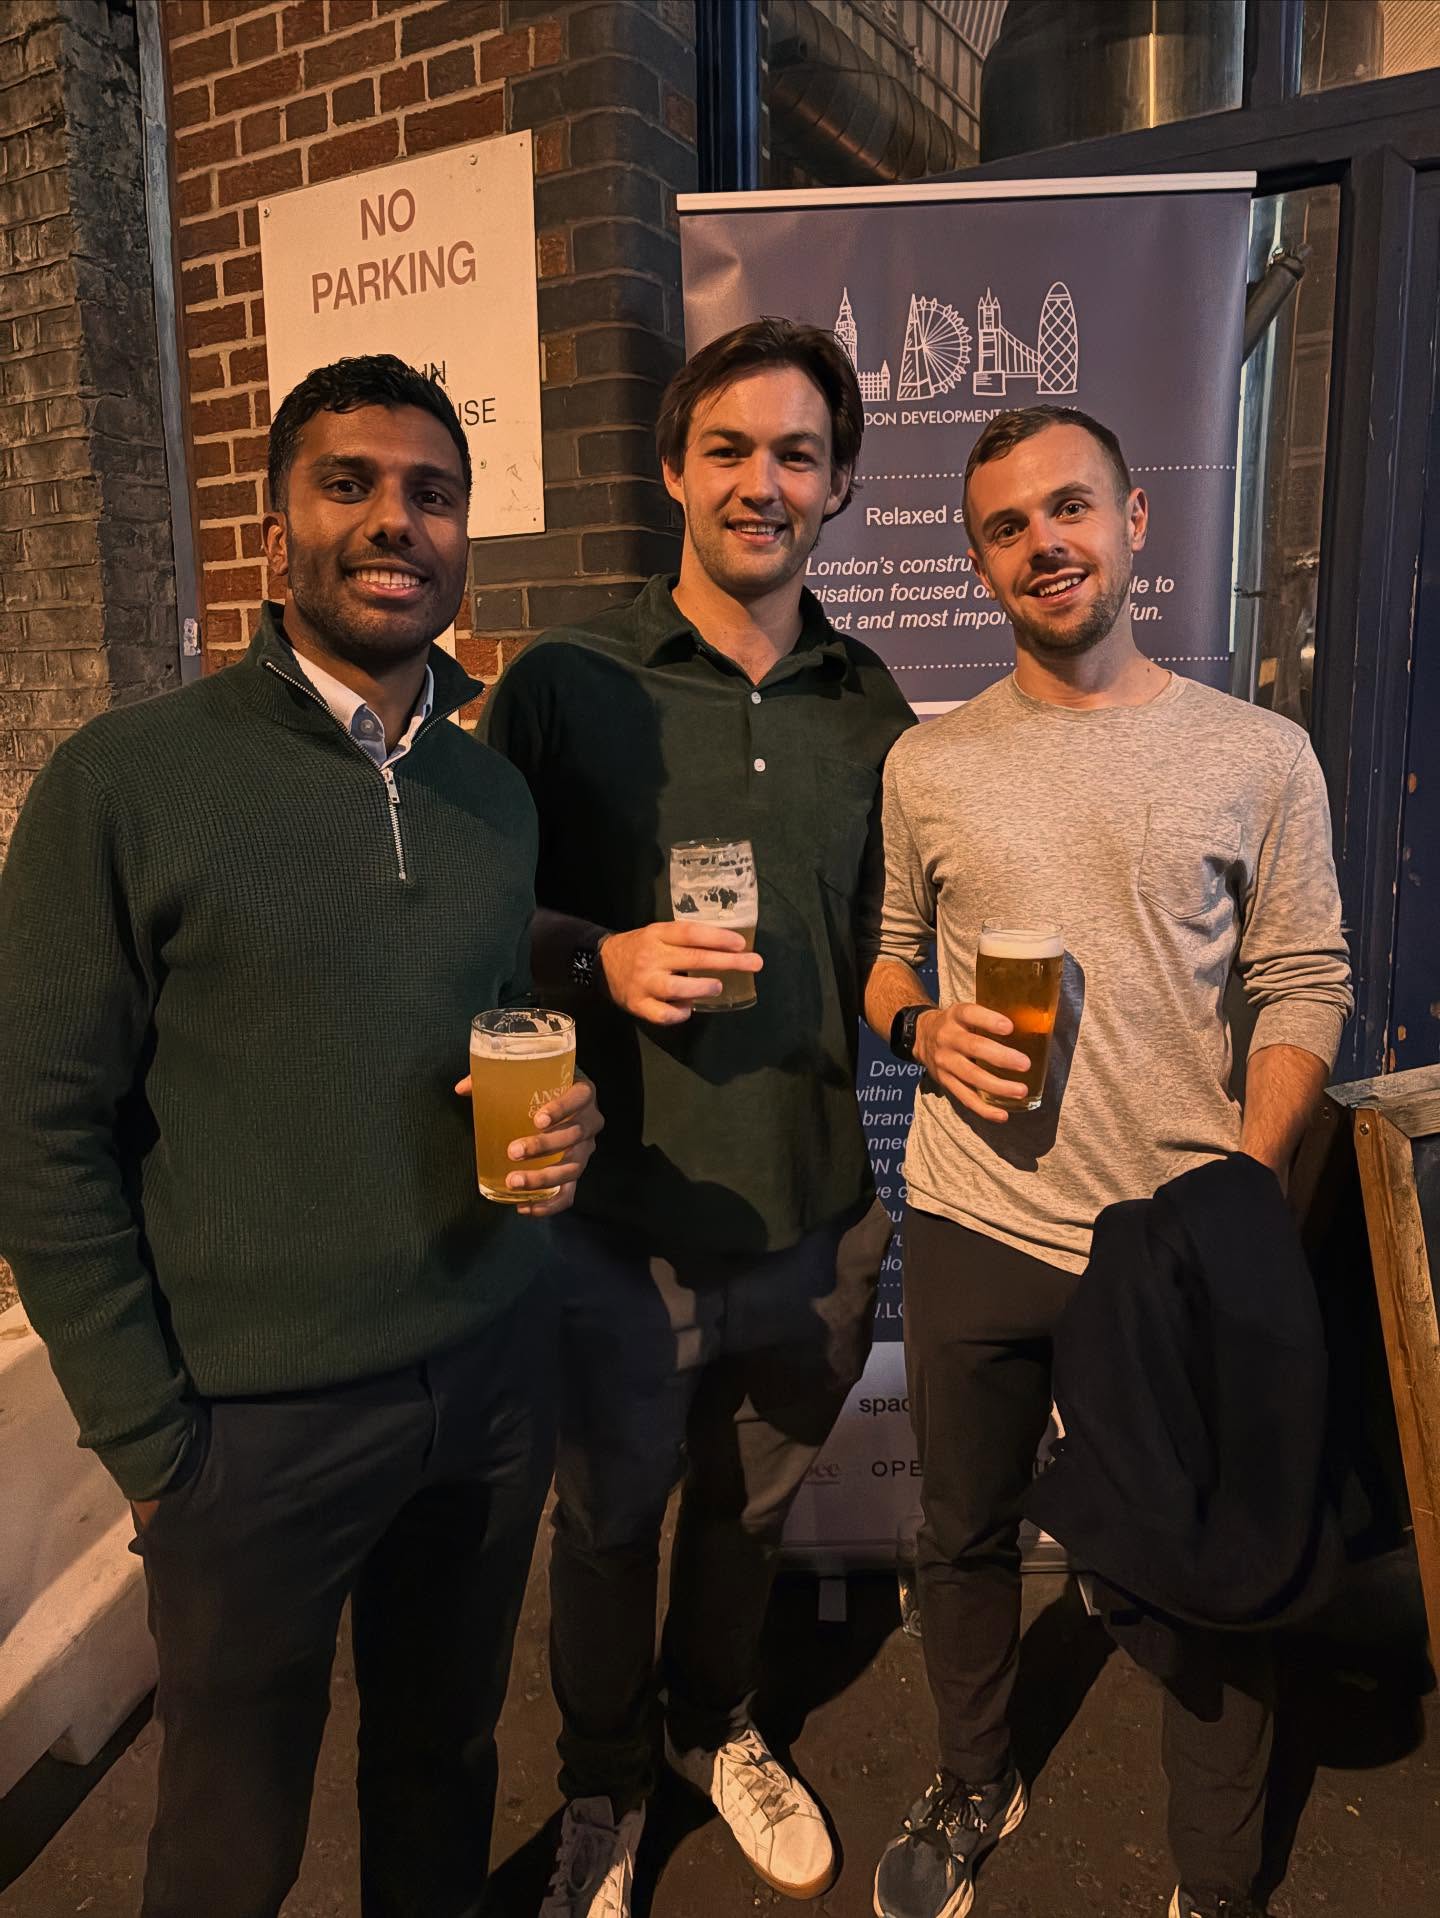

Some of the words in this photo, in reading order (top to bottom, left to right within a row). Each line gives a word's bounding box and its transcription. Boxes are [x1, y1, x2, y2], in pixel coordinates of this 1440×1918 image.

[360, 188, 416, 241] NO
[311, 240, 477, 314] PARKING
[864, 411, 897, 426] DON
[901, 408, 1002, 425] DEVELOPMENT
[866, 504, 947, 526] Relaxed
[952, 509, 965, 524] a
[899, 553, 974, 575] constru
[810, 584, 885, 604] nisation
[890, 580, 969, 602] focused
[1129, 575, 1150, 594] le
[1155, 575, 1175, 593] to
[827, 612, 853, 630] ect
[856, 610, 895, 630] and
[899, 609, 949, 628] most
[871, 1460, 922, 1477] OPE
